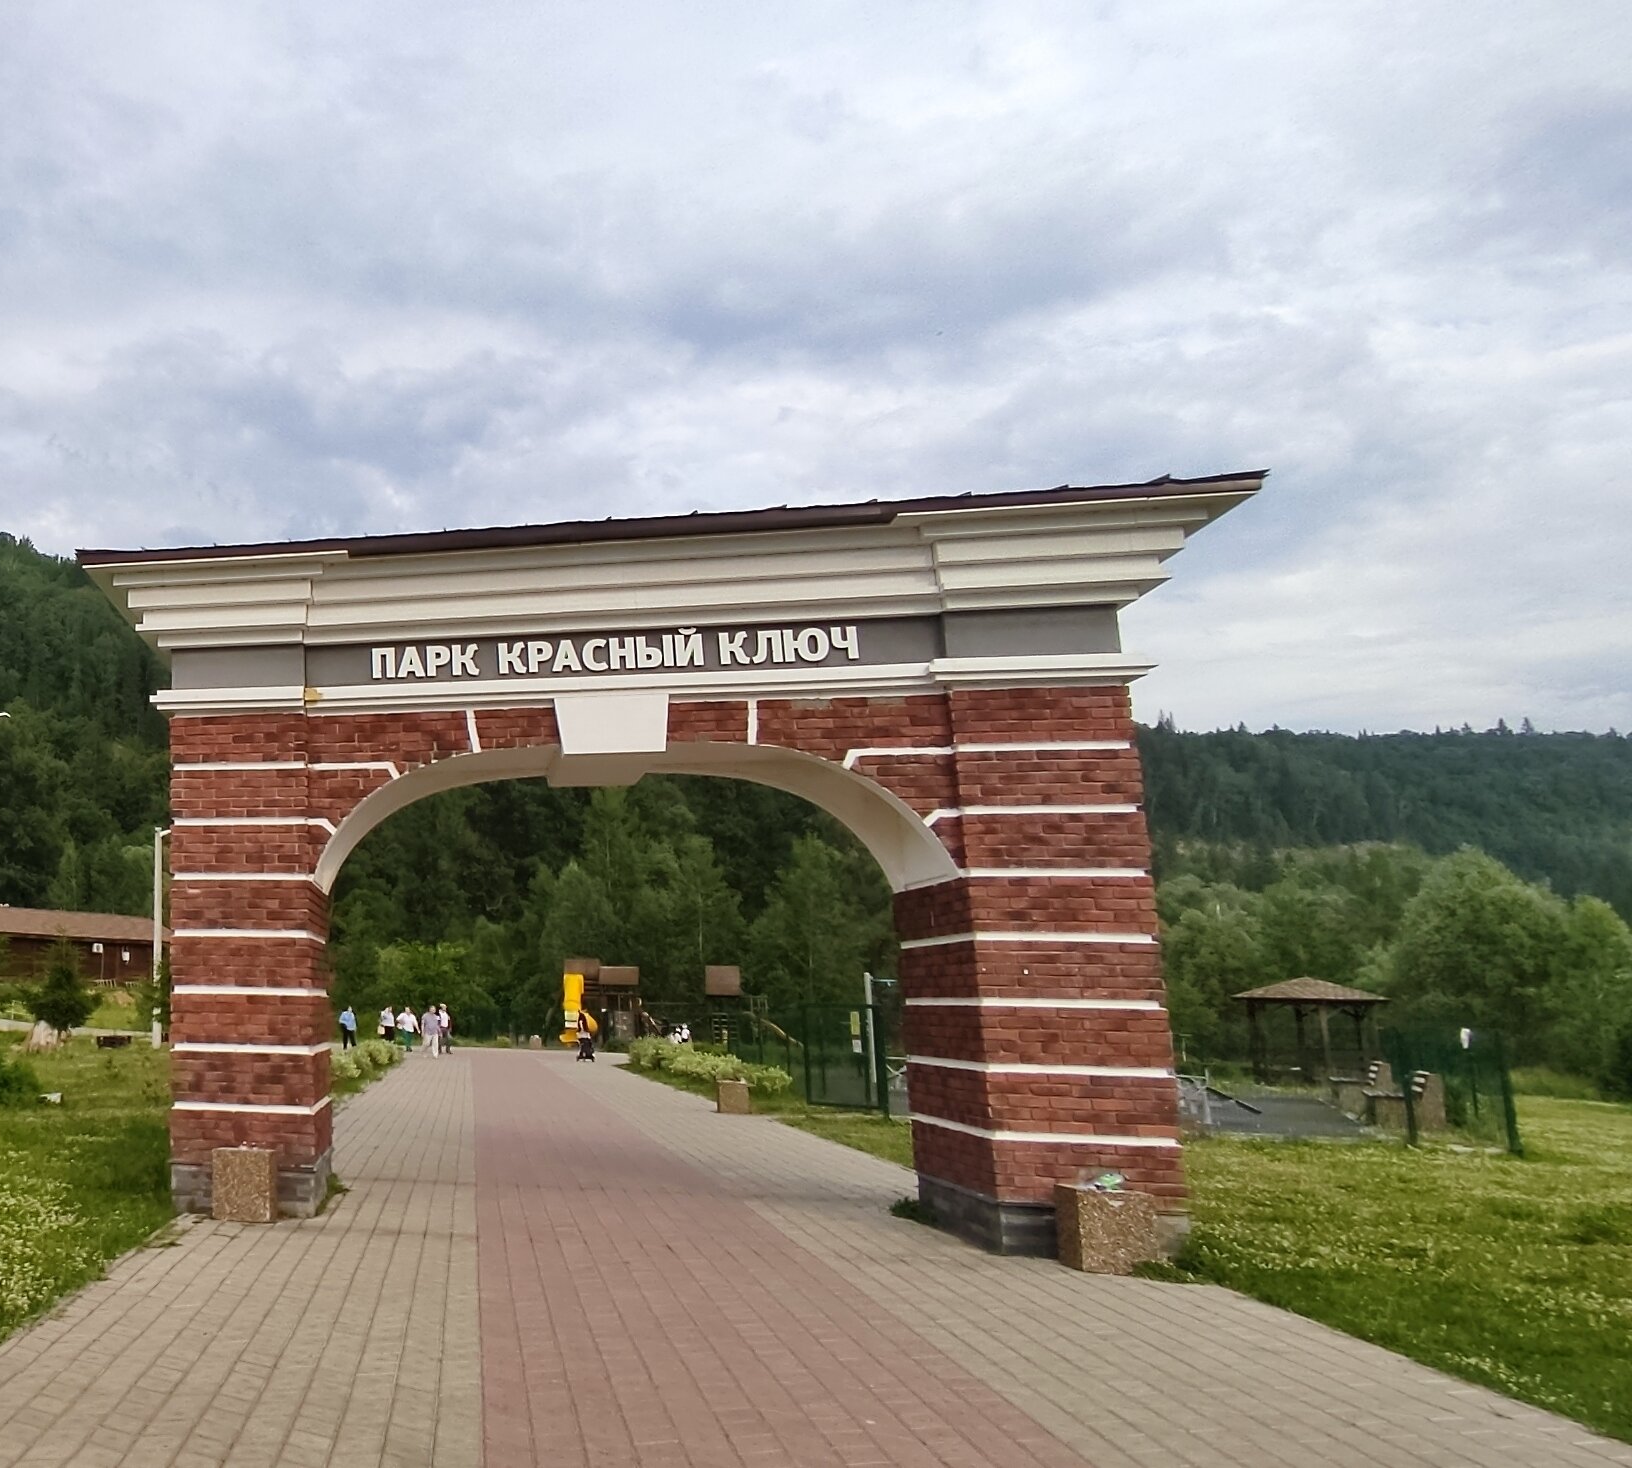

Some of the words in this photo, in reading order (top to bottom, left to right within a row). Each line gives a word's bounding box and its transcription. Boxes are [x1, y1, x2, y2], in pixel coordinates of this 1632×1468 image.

[371, 643, 480, 680] ПАРК
[497, 627, 704, 676] КРАСНЫЙ
[719, 626, 860, 665] КЛЮЧ
